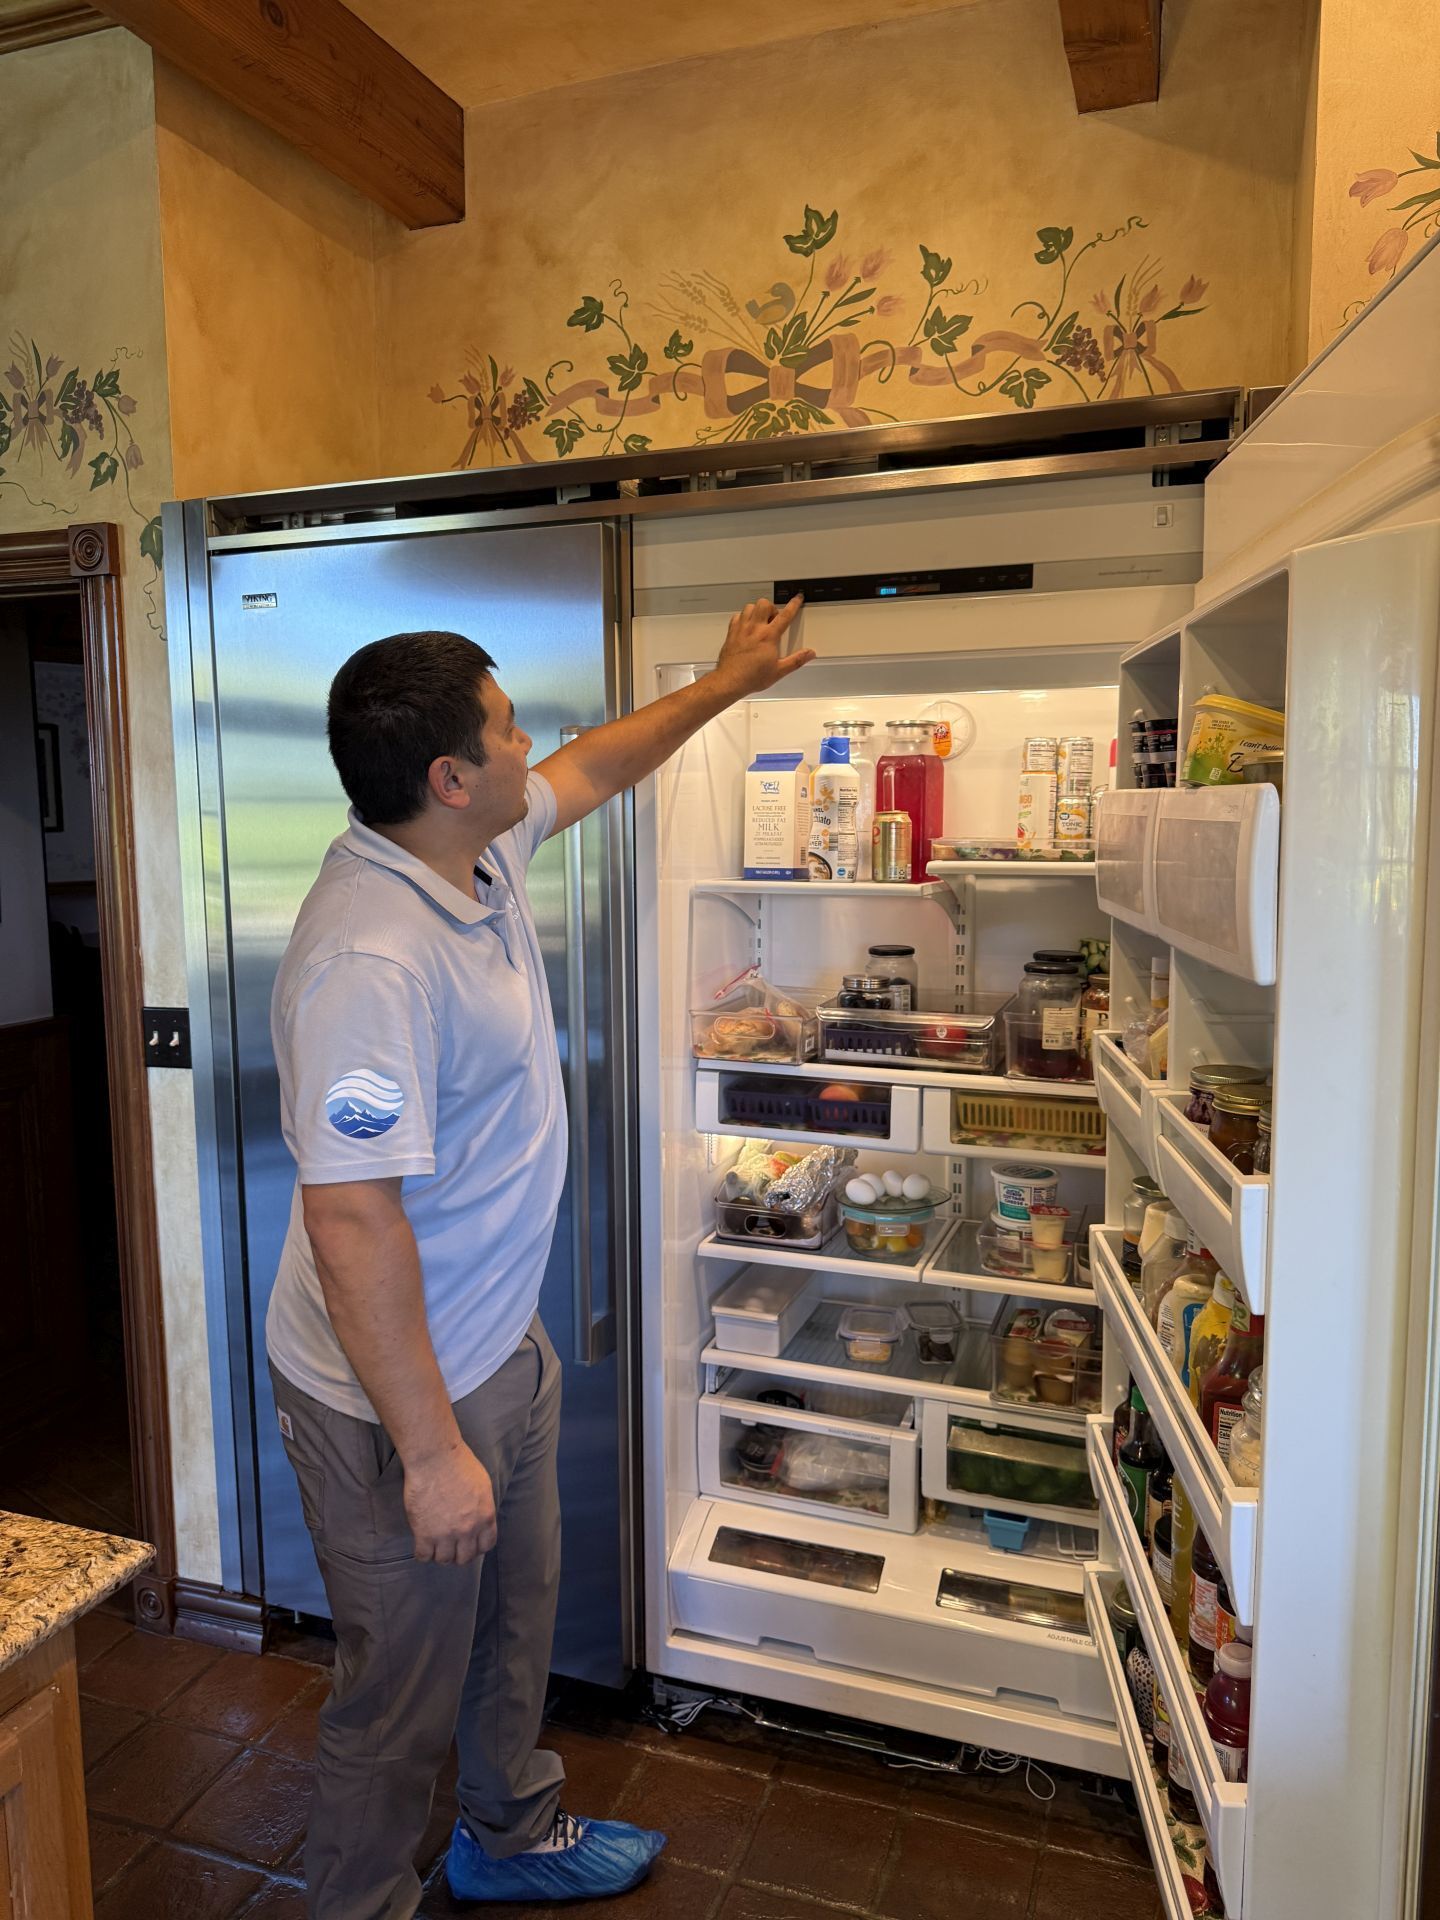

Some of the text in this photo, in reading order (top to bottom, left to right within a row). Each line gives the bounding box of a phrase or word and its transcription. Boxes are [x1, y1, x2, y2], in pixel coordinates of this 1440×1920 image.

[1261, 743, 1284, 751] belie
[758, 823, 780, 831] MILK
[1219, 1408, 1242, 1418] Nutrition
[1046, 1633, 1084, 1645] ADJUSTABLE
